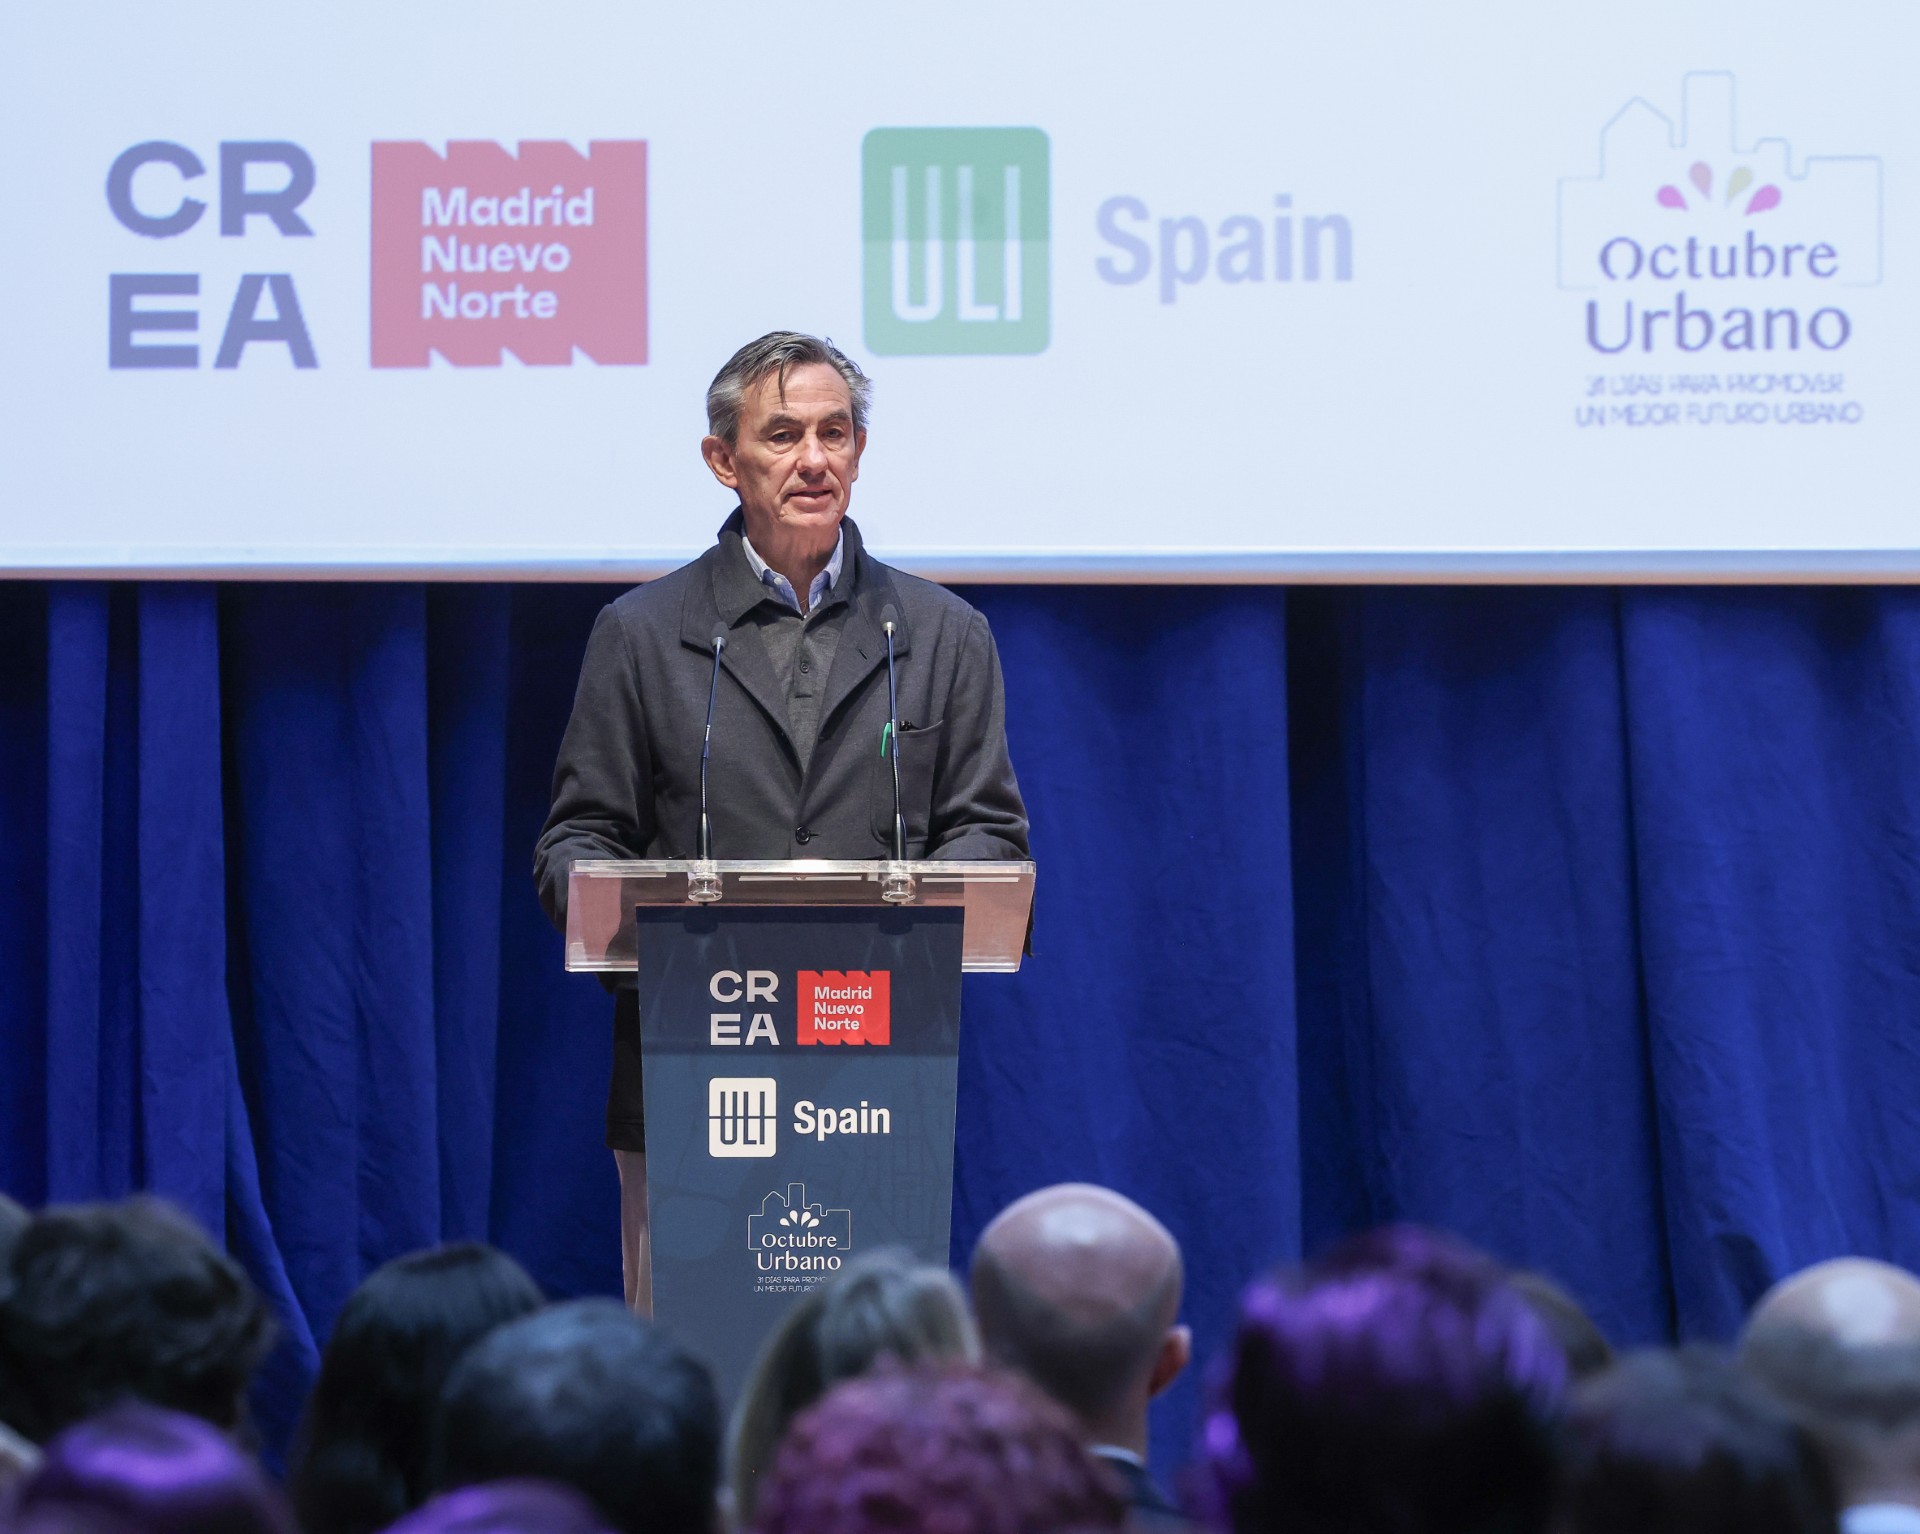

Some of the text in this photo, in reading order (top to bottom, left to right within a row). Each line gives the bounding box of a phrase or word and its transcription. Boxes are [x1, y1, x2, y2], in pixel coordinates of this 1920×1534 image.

[106, 139, 317, 239] CR
[421, 186, 595, 227] Madrid
[421, 236, 571, 273] Nuevo
[890, 165, 1023, 322] ULI
[1094, 193, 1354, 305] Spain
[1598, 229, 1839, 281] Octubre
[421, 282, 559, 320] Norte
[108, 273, 319, 369] EA
[1585, 290, 1851, 355] Urbano
[1575, 404, 1605, 427] UN
[1774, 401, 1864, 425] URBANO
[709, 970, 779, 1003] CR
[814, 986, 872, 1000] Madrid
[813, 1001, 864, 1015] Nuevo
[814, 1016, 860, 1030] Norte
[710, 1013, 780, 1046] EA
[720, 1091, 766, 1145] ULI
[793, 1100, 891, 1142] Spain
[762, 1232, 836, 1247] Octubre
[757, 1250, 841, 1270] Urbano
[757, 1276, 764, 1284] 31
[783, 1276, 801, 1284] PARA
